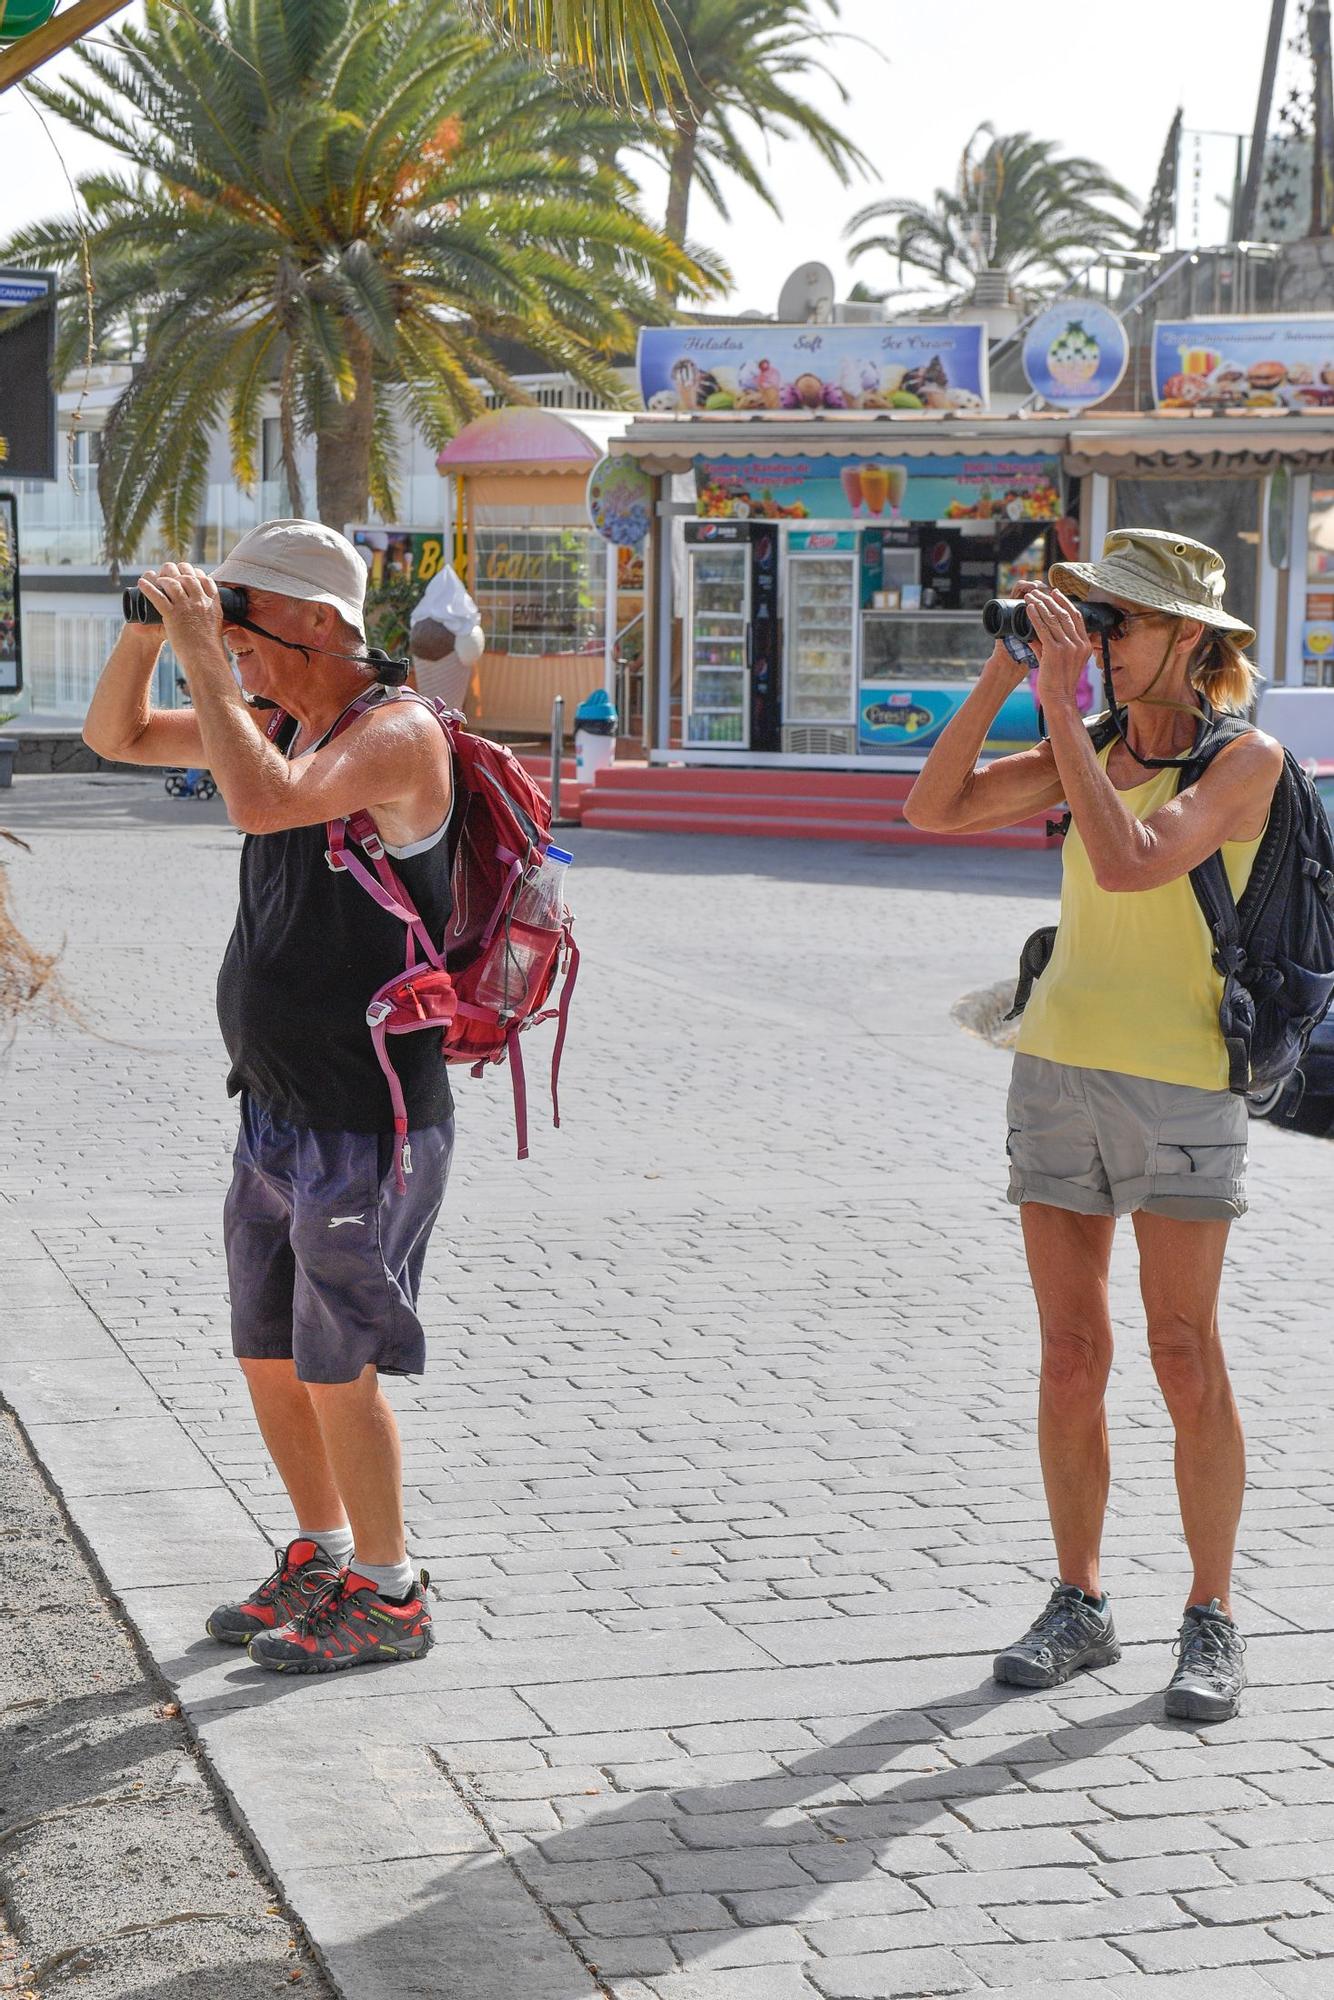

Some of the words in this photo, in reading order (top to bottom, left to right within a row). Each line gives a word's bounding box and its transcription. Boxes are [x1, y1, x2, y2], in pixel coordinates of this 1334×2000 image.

[683, 336, 744, 350] Helados
[794, 335, 823, 352] Soft
[881, 335, 902, 349] Ice
